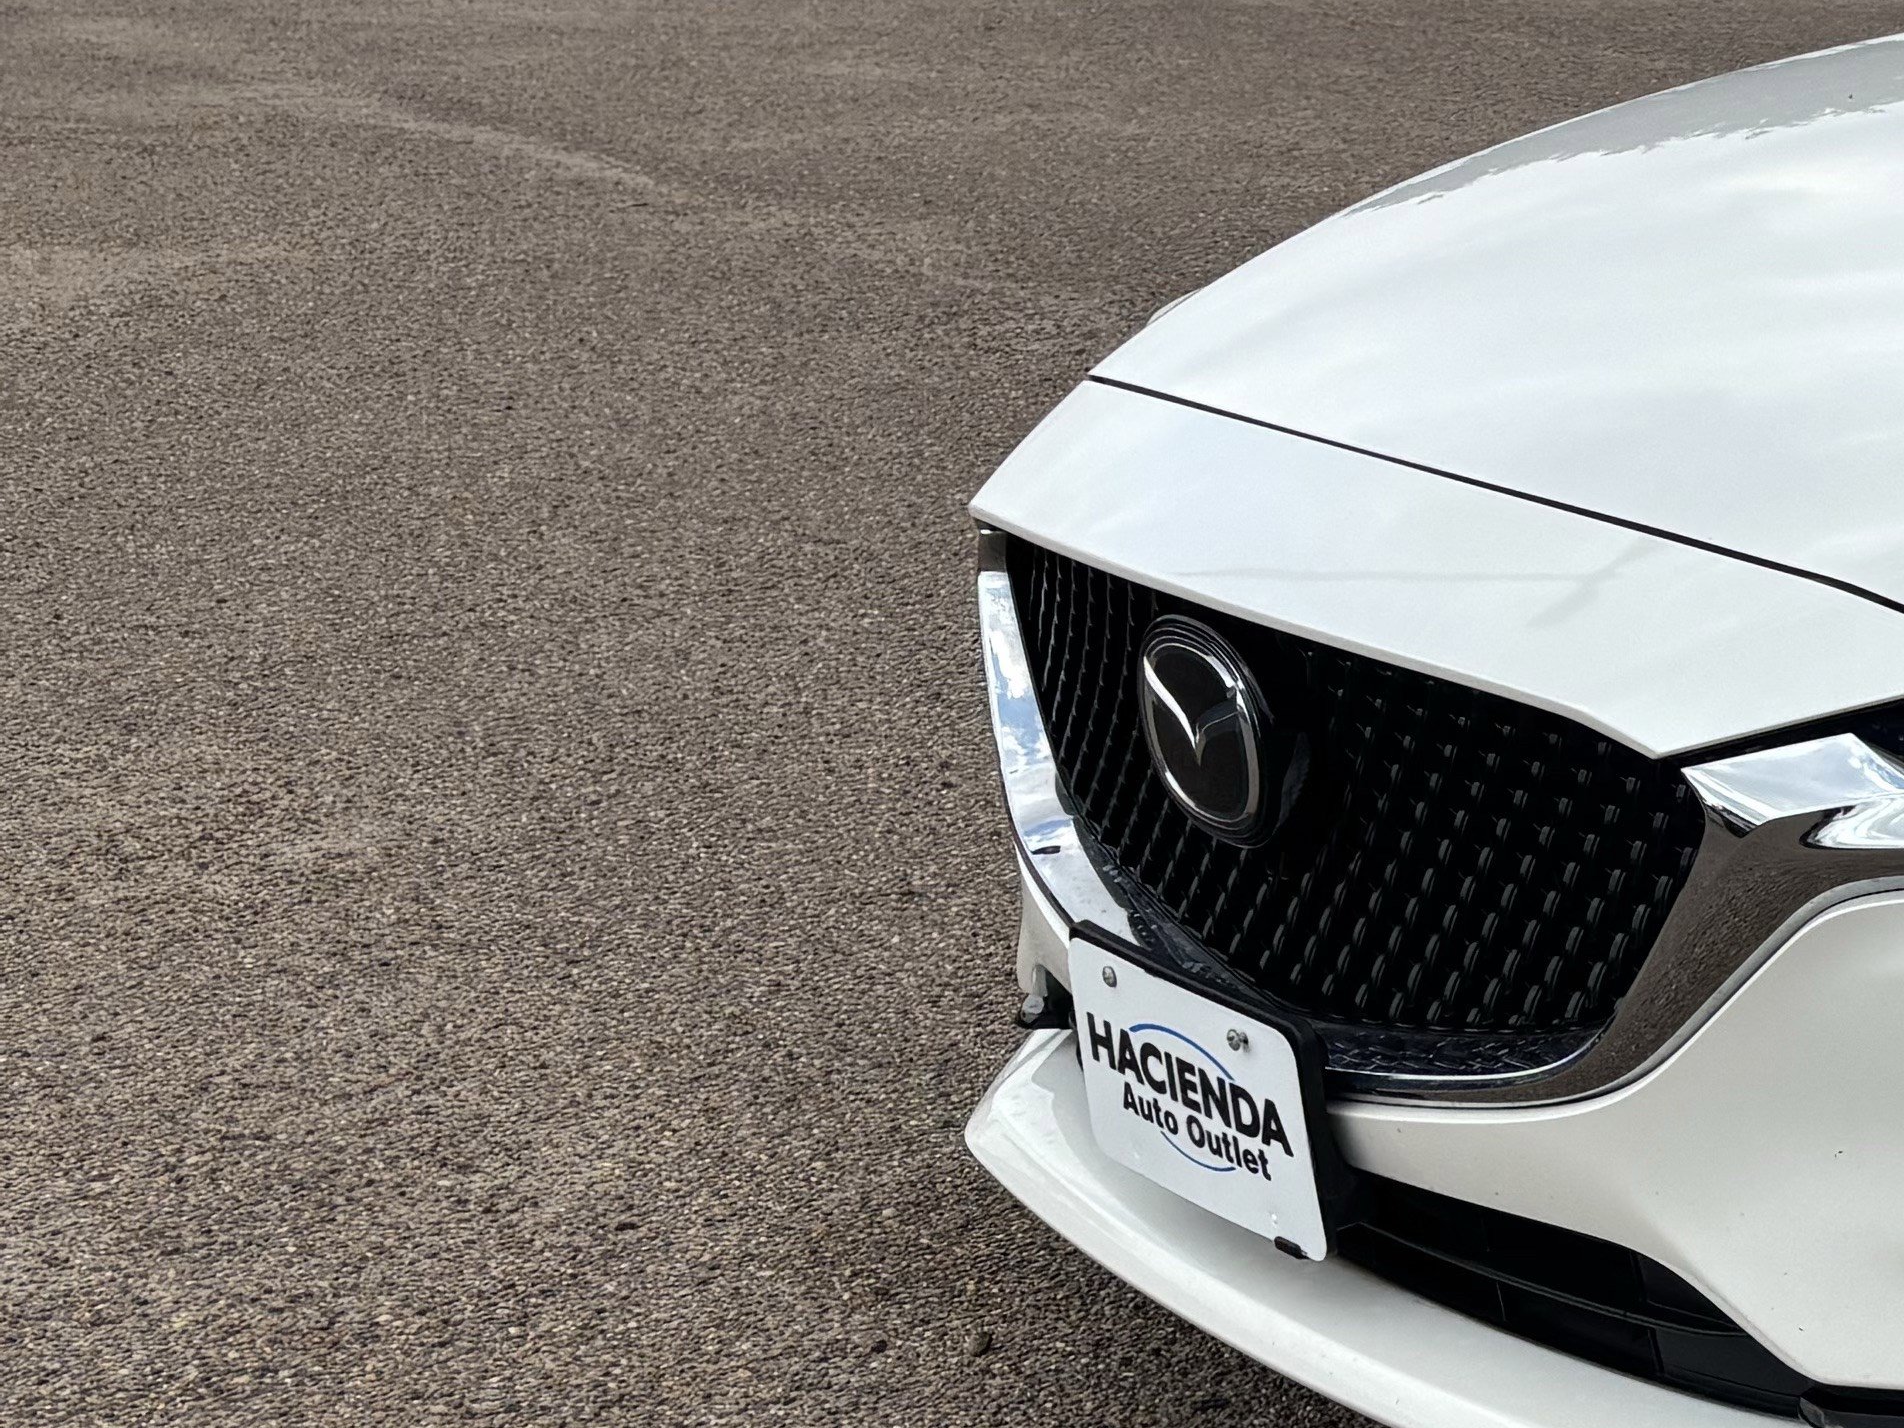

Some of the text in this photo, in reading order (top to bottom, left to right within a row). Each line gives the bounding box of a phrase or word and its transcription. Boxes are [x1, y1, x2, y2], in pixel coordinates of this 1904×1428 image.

[1086, 1012, 1294, 1158] HACIENDA
[1122, 1081, 1273, 1181] Auto Outlet
